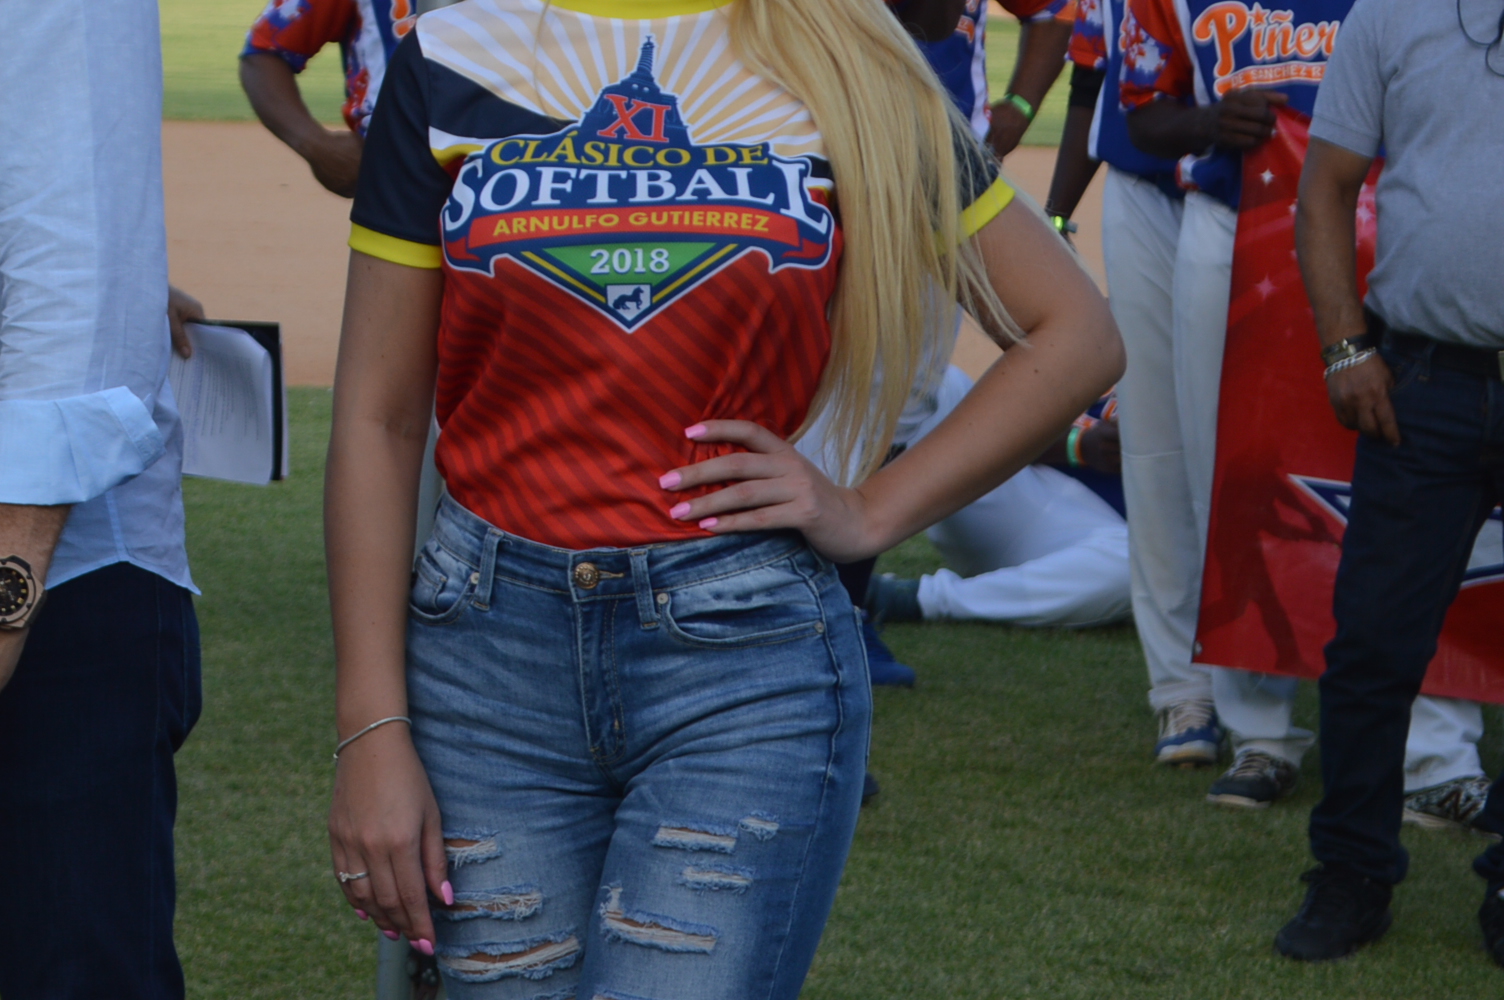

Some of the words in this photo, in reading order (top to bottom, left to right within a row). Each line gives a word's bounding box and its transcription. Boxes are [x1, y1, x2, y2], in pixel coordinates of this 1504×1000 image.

[1192, 0, 1340, 78] Piñer
[1249, 63, 1307, 81] SANCHEZ
[597, 93, 672, 143] XI
[490, 131, 692, 167] CLÁSICO
[702, 144, 770, 166] DE
[443, 157, 829, 235] SOFTBALL
[492, 213, 620, 237] ARNULFO
[627, 210, 770, 233] GUTIERREZ
[590, 247, 671, 275] 2018
